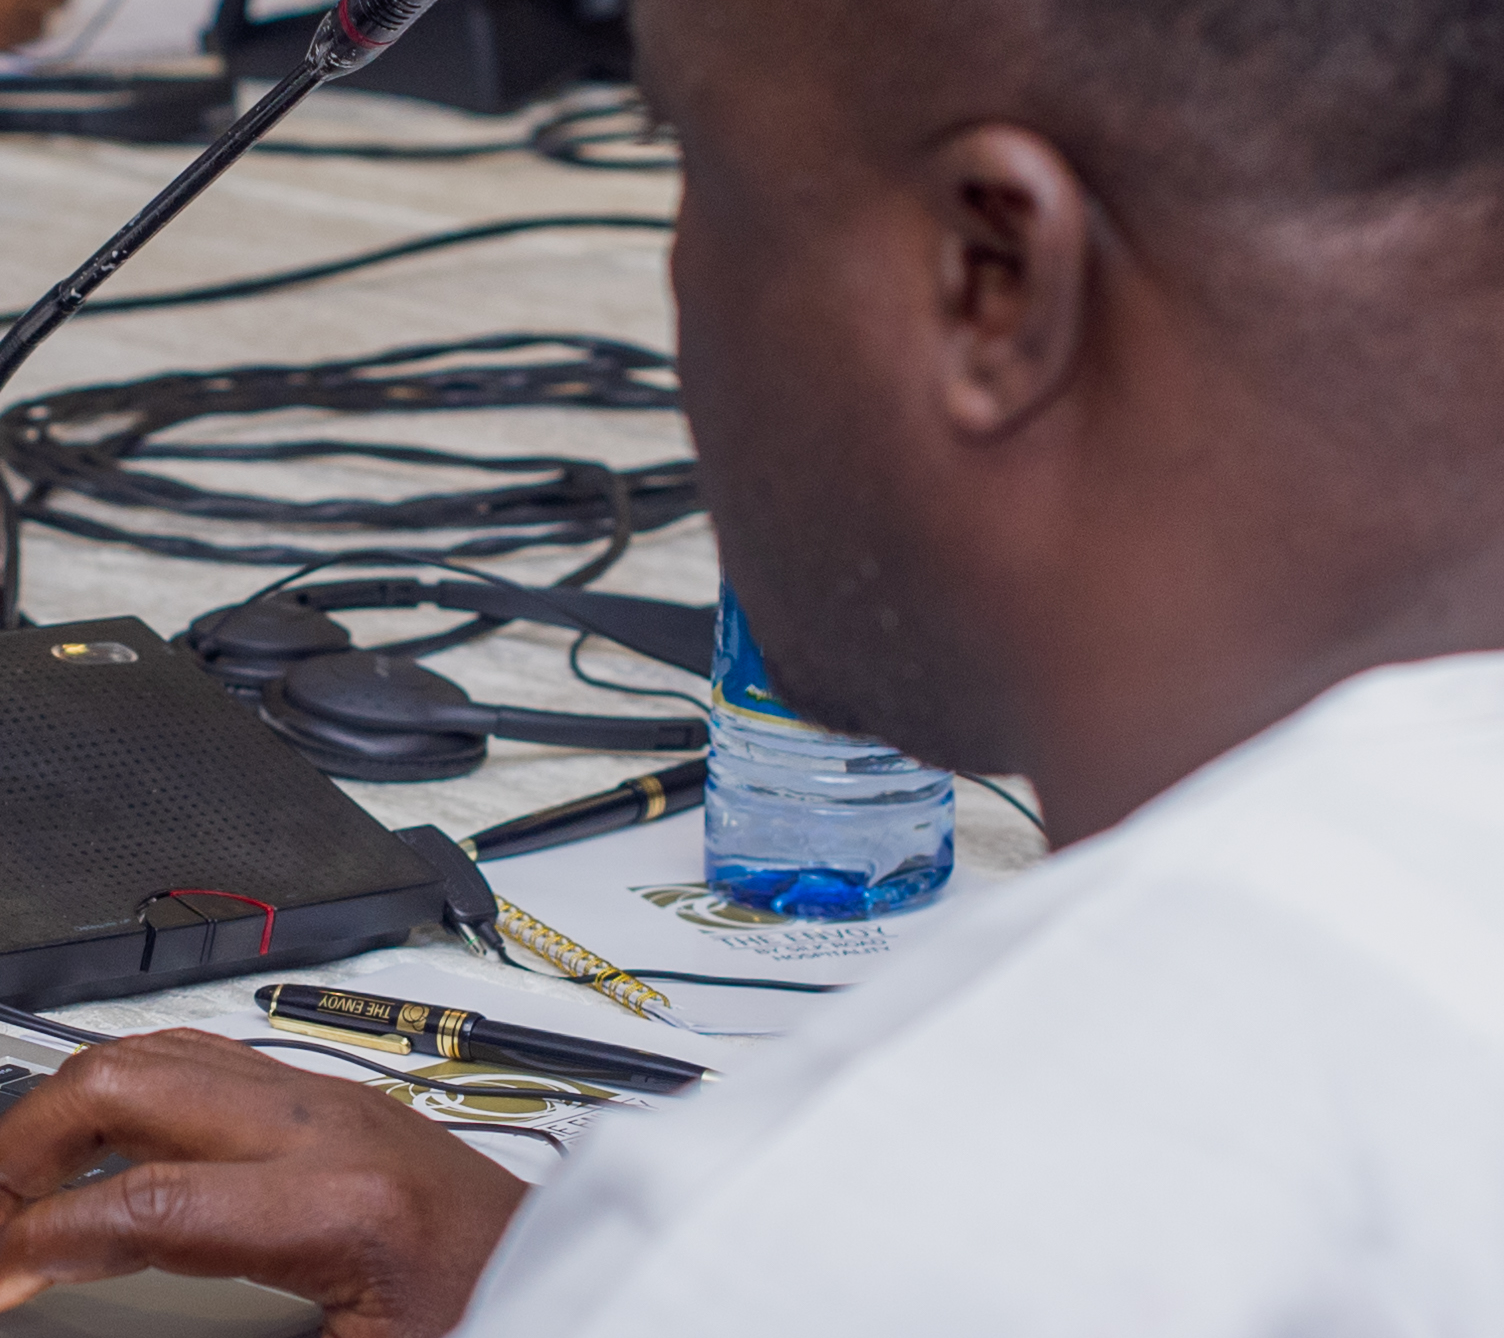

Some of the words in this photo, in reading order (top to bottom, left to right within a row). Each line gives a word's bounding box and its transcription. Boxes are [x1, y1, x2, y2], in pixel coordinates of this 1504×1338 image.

[721, 934, 772, 950] THE
[782, 925, 886, 943] ENVOY
[773, 945, 890, 961] HOSPITALITY
[319, 995, 363, 1015] ENVOY
[364, 1001, 392, 1022] THE
